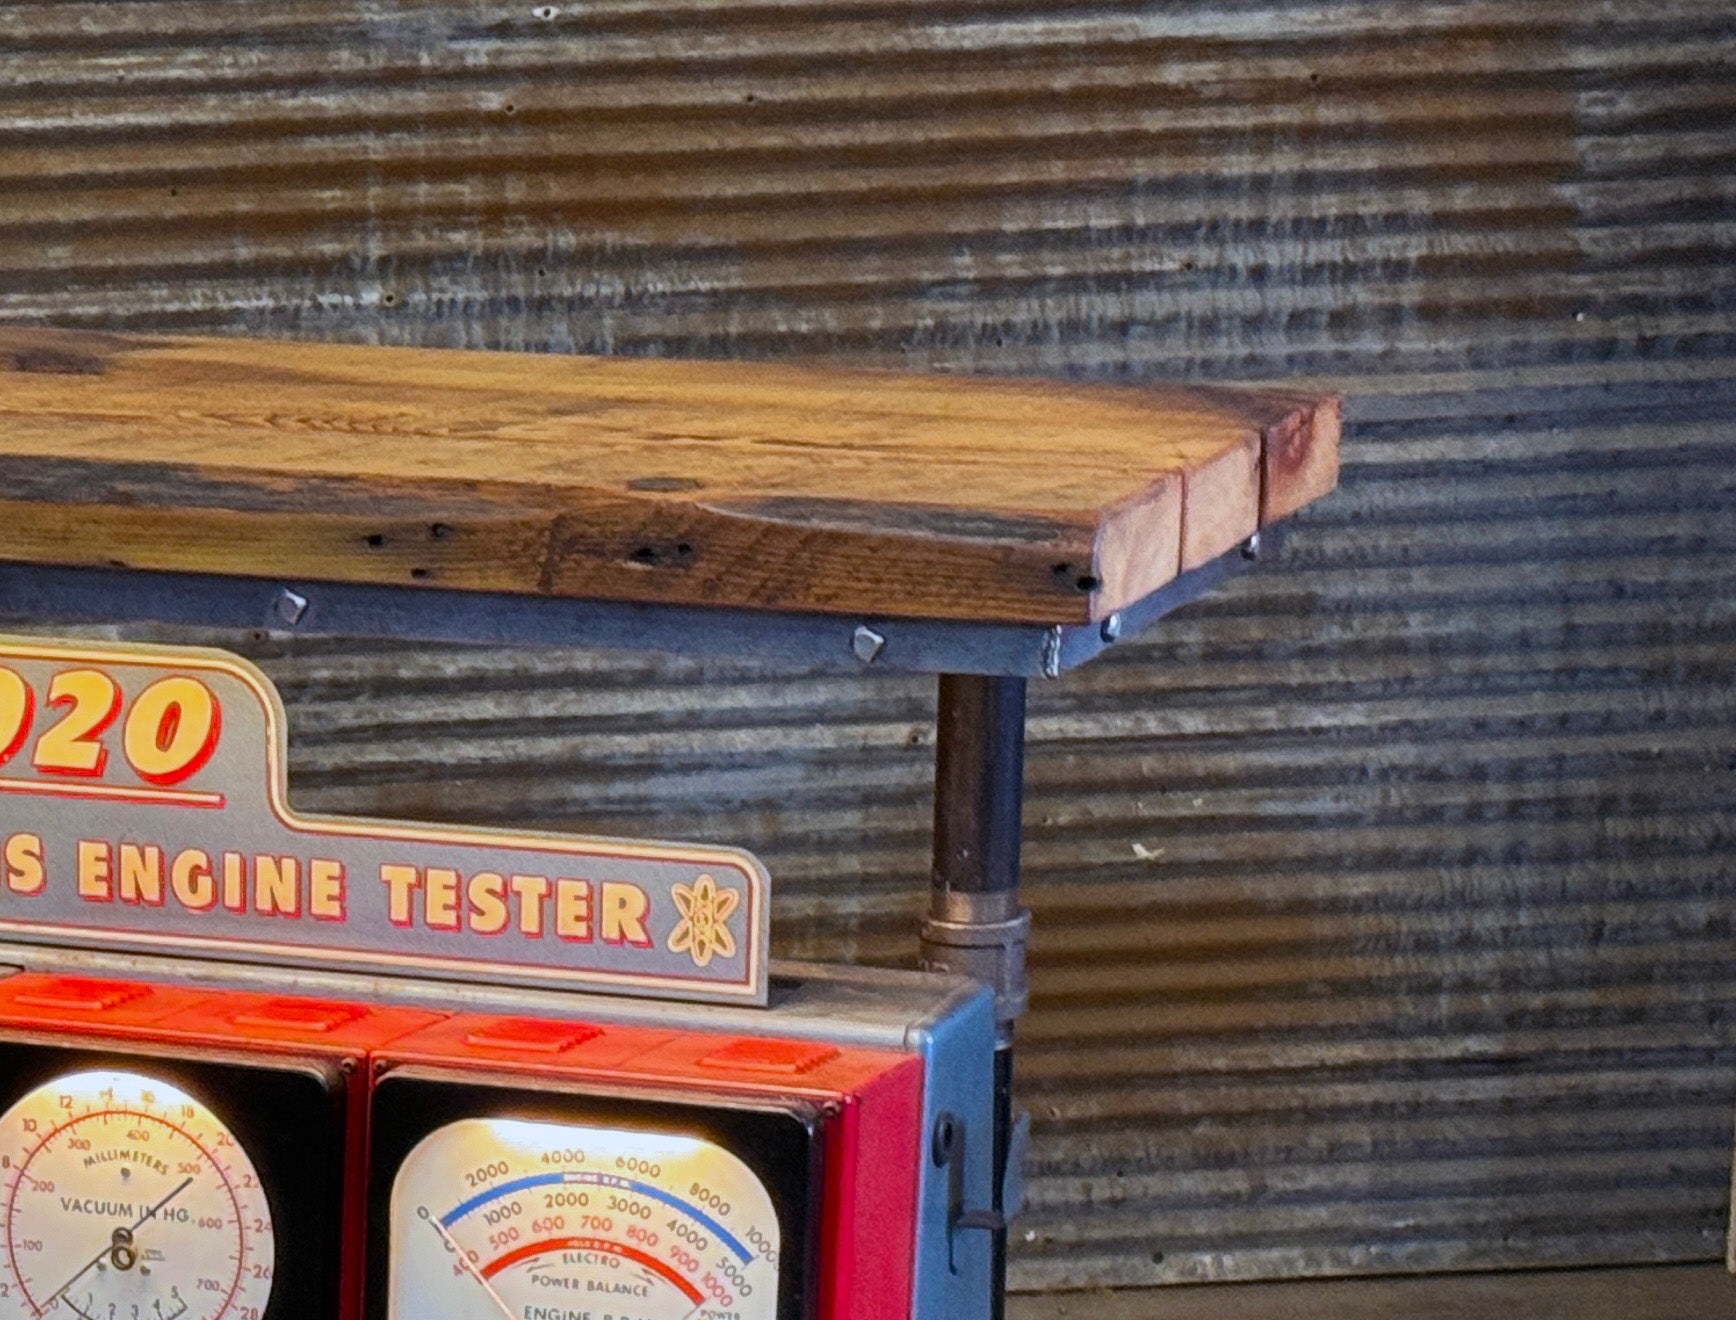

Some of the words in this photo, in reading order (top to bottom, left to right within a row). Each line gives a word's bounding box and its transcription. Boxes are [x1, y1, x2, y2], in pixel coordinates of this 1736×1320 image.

[77, 840, 346, 922] ENGINE
[380, 864, 652, 948] TESTER
[67, 1138, 91, 1151] 300
[82, 1150, 170, 1176] MILLIMETERS
[177, 1162, 202, 1175] 500
[0, 1283, 9, 1297] 2
[22, 1118, 37, 1133] 10
[59, 1094, 74, 1109] 12
[31, 1180, 55, 1193] 200
[417, 1205, 430, 1221] 0
[465, 1160, 510, 1188] 2000
[540, 1149, 586, 1165] 4000
[615, 1156, 662, 1179] 6000
[689, 1182, 732, 1217] 8000
[60, 1196, 133, 1217] VACUUM
[198, 1216, 223, 1230] 600
[22, 1239, 43, 1252] 100
[482, 1200, 523, 1226] 1000
[543, 1192, 590, 1209] 2000
[606, 1195, 652, 1220] 3000
[666, 1216, 708, 1251] 4000
[715, 1256, 753, 1298] 5000
[489, 1226, 521, 1250] 500
[532, 1214, 566, 1235] 600
[581, 1214, 613, 1233] 700
[626, 1223, 659, 1248] 800
[668, 1245, 700, 1274] 900
[702, 1271, 734, 1308] 1000
[562, 1252, 621, 1270] ELECTRO
[530, 1273, 580, 1291] POWER
[587, 1280, 649, 1298] BALANCE
